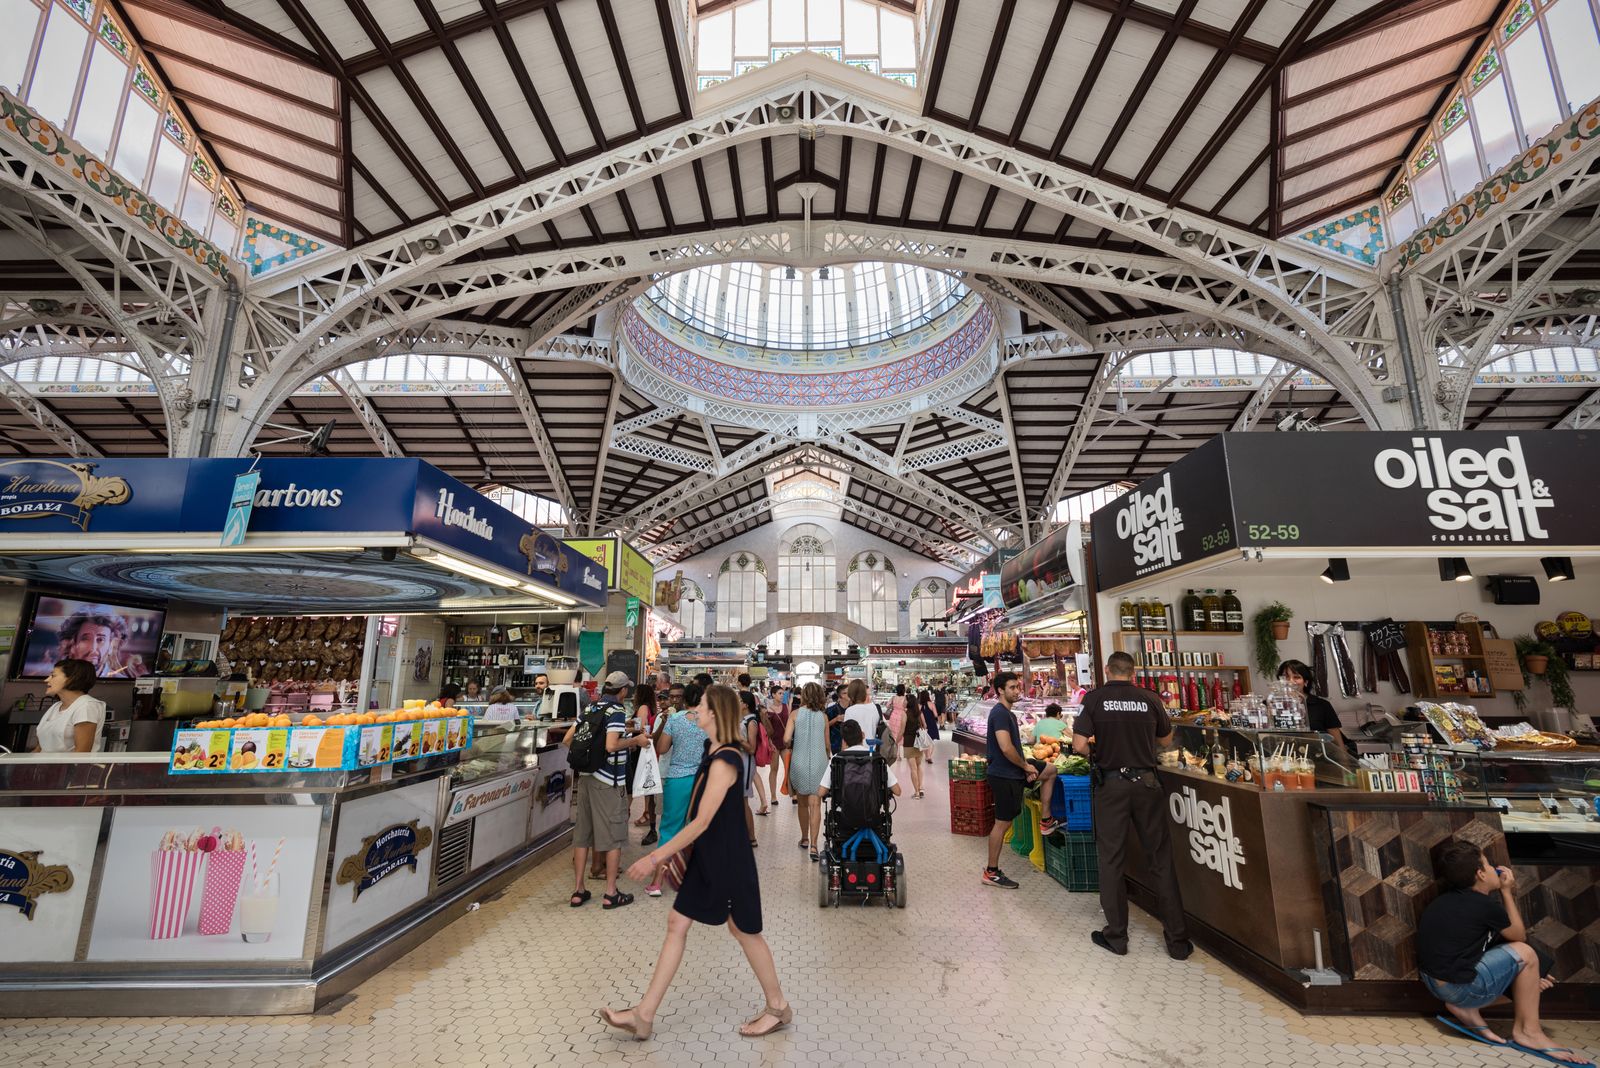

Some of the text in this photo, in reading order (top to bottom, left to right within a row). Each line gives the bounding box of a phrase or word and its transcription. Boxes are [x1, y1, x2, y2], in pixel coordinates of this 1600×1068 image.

[1373, 435, 1551, 498] oiled &
[3, 475, 79, 493] Huertana
[253, 482, 343, 507] artons
[437, 488, 494, 541] Horchata
[1116, 472, 1183, 540] oiled &
[1427, 488, 1555, 542] salt
[1202, 529, 1230, 551] 52-59
[1249, 524, 1300, 540] 52-59
[1133, 522, 1184, 567] salt
[873, 646, 925, 654] Moixamer
[1103, 701, 1148, 712] SEGURIDAD
[209, 754, 218, 767] 2
[266, 753, 276, 766] 2
[380, 748, 386, 760] 2
[1169, 785, 1243, 855] oiled &
[1189, 830, 1246, 890] salt
